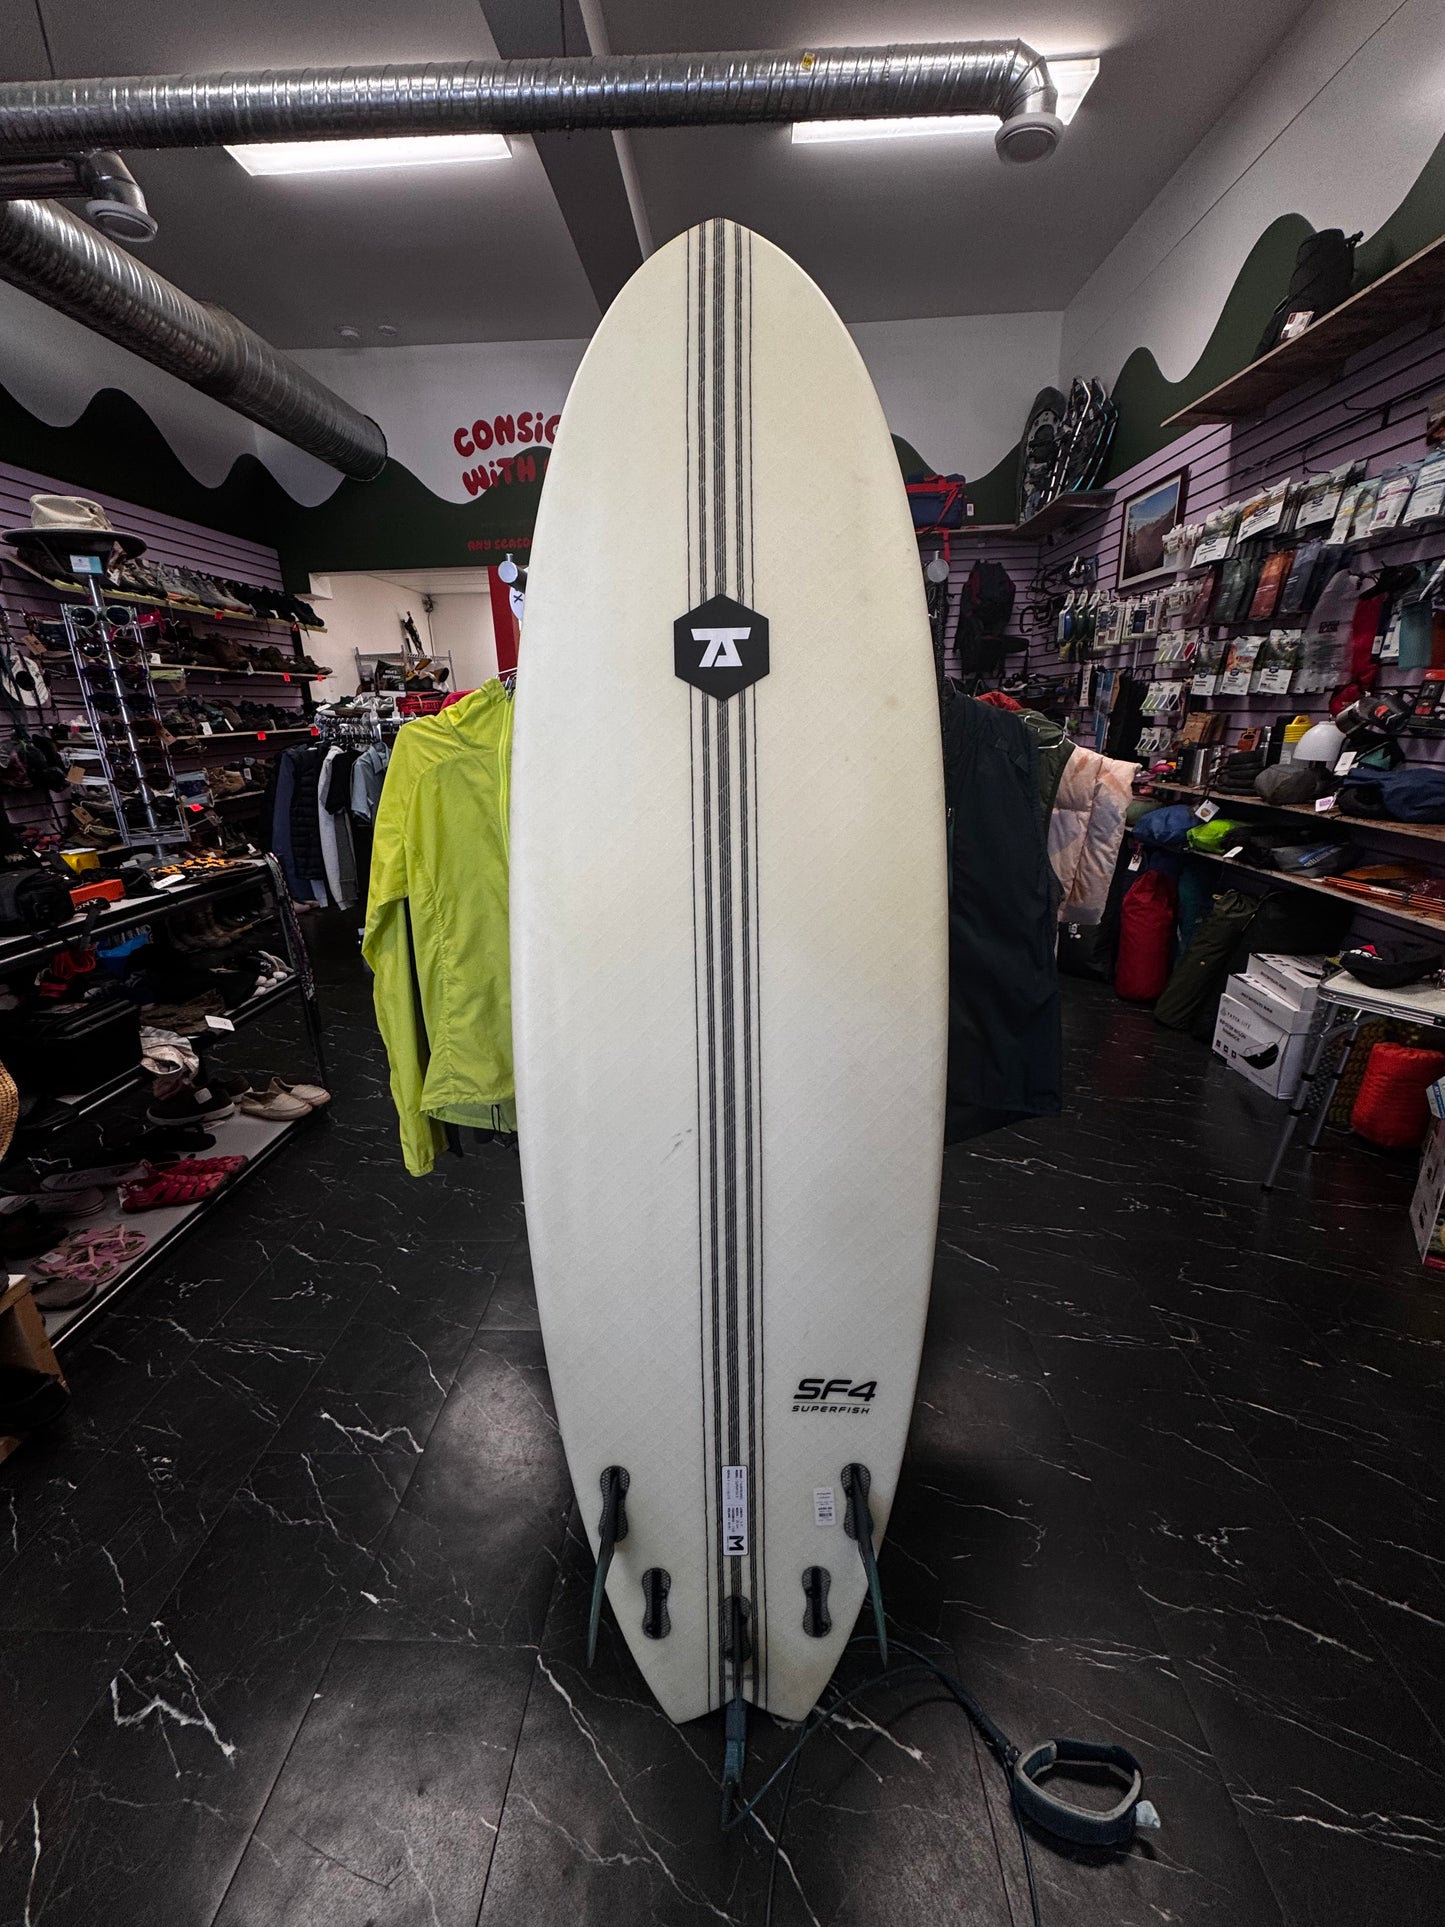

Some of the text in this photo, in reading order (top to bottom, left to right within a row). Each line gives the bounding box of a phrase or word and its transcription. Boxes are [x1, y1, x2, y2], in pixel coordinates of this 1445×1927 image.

[467, 537, 533, 551] ANY SEASO
[74, 898, 99, 911] ONY
[793, 1378, 878, 1402] SF4
[791, 1405, 870, 1415] SUPERFISH
[728, 1535, 745, 1551] M
